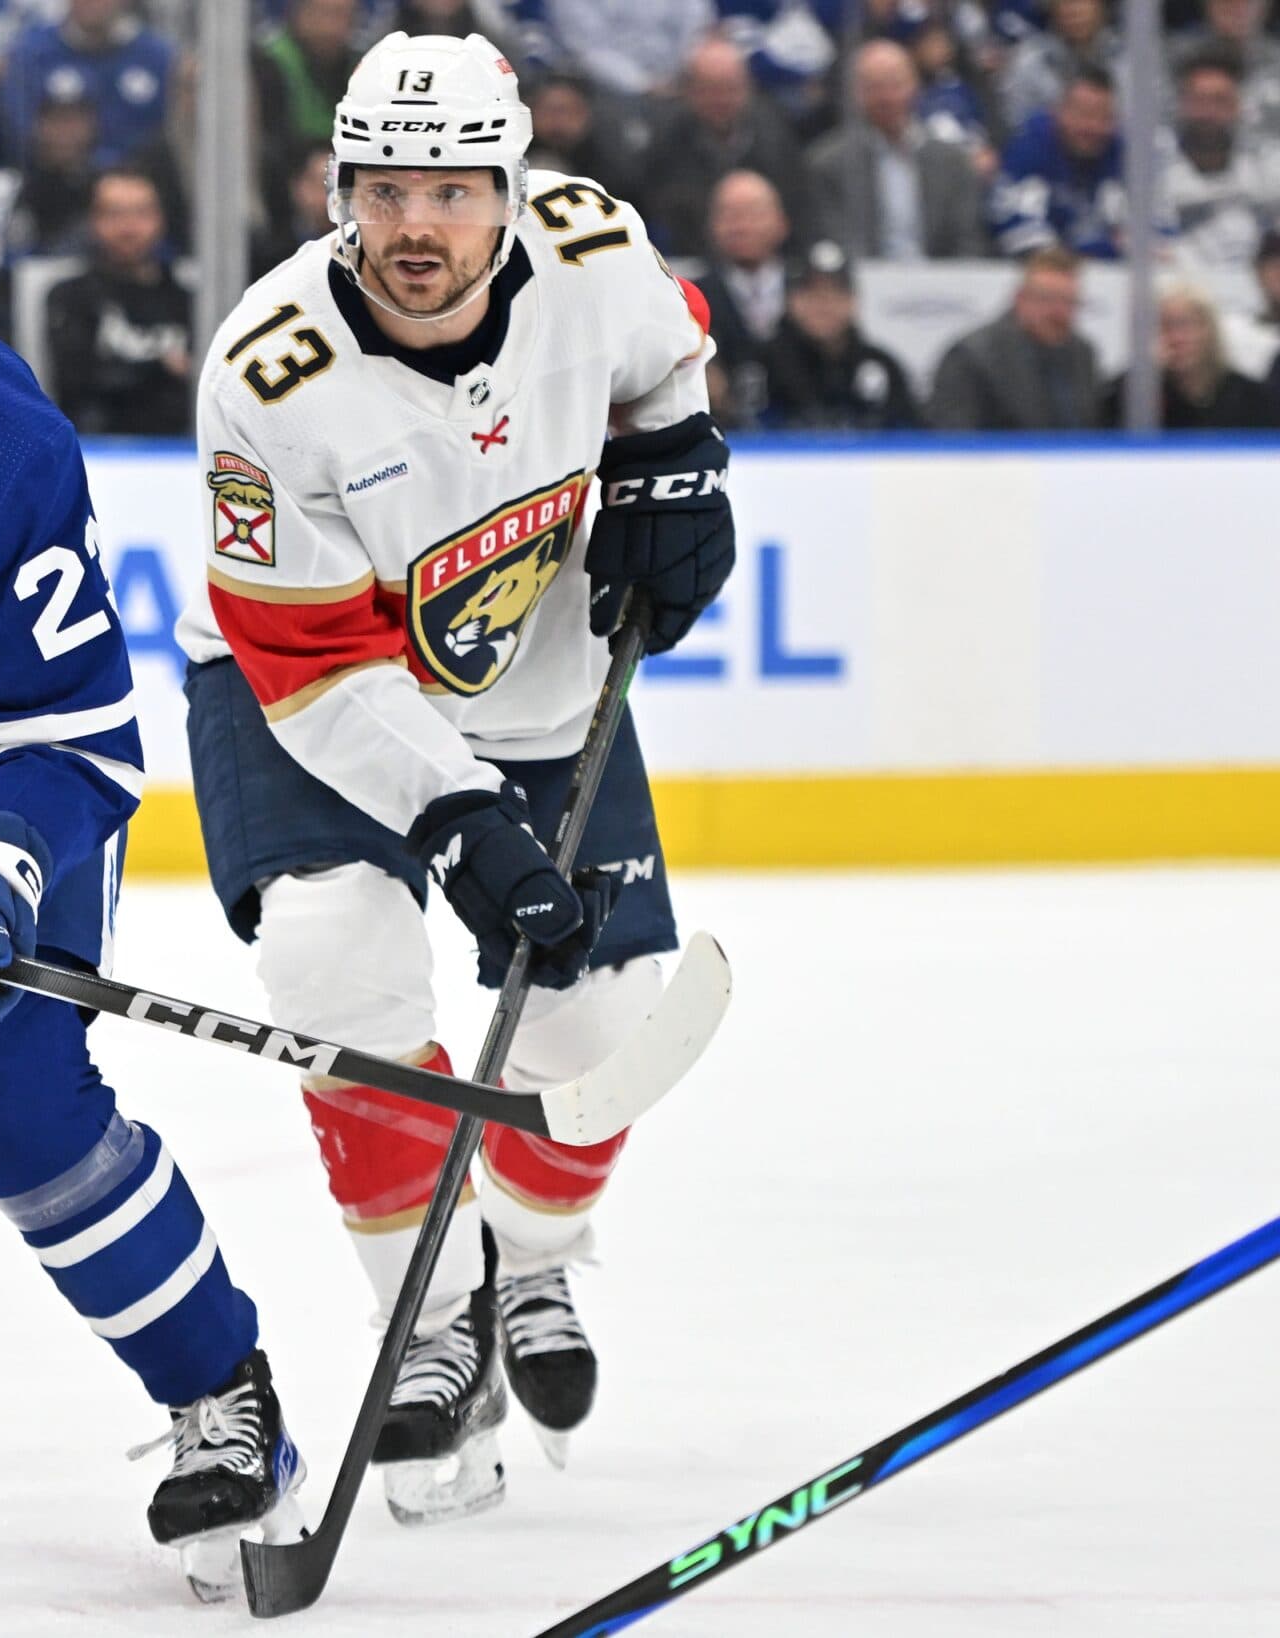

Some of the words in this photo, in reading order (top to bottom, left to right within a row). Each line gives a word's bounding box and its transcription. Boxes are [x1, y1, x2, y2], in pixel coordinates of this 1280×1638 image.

[397, 69, 434, 93] 13
[380, 120, 447, 133] CCM
[531, 182, 632, 267] 13
[223, 301, 337, 406] 13
[346, 462, 408, 493] AutoNation
[607, 468, 727, 506] CCM
[432, 491, 571, 588] FLORIDA
[516, 902, 553, 917] CCM
[126, 992, 343, 1075] CCM
[668, 1457, 864, 1590] SYNC
